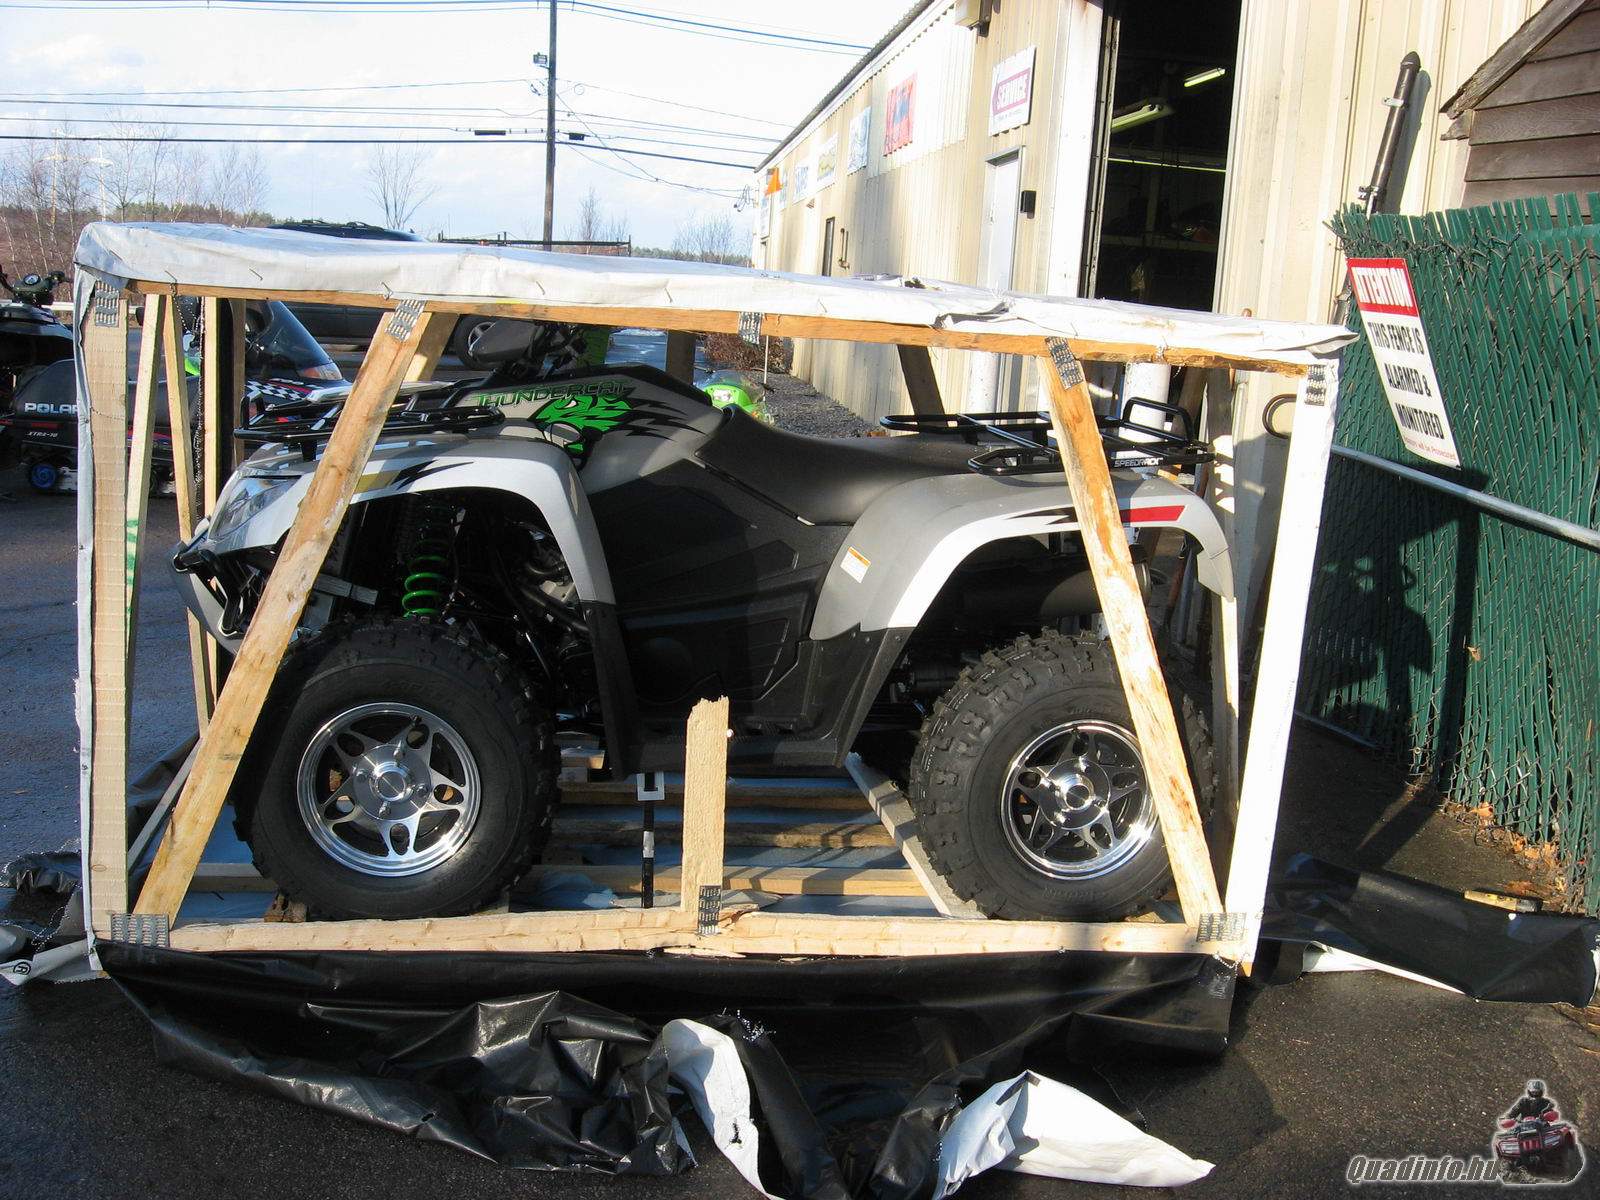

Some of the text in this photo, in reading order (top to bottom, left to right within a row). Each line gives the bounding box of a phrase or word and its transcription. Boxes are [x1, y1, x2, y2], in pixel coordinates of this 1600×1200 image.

[1352, 267, 1412, 306] ATTENTION
[1367, 321, 1425, 356] THIS FENCE IS
[477, 380, 626, 406] THUNDERCAT
[1384, 362, 1432, 397] ALARMED &
[24, 402, 78, 414] POLAR
[1394, 402, 1445, 440] MONITORED
